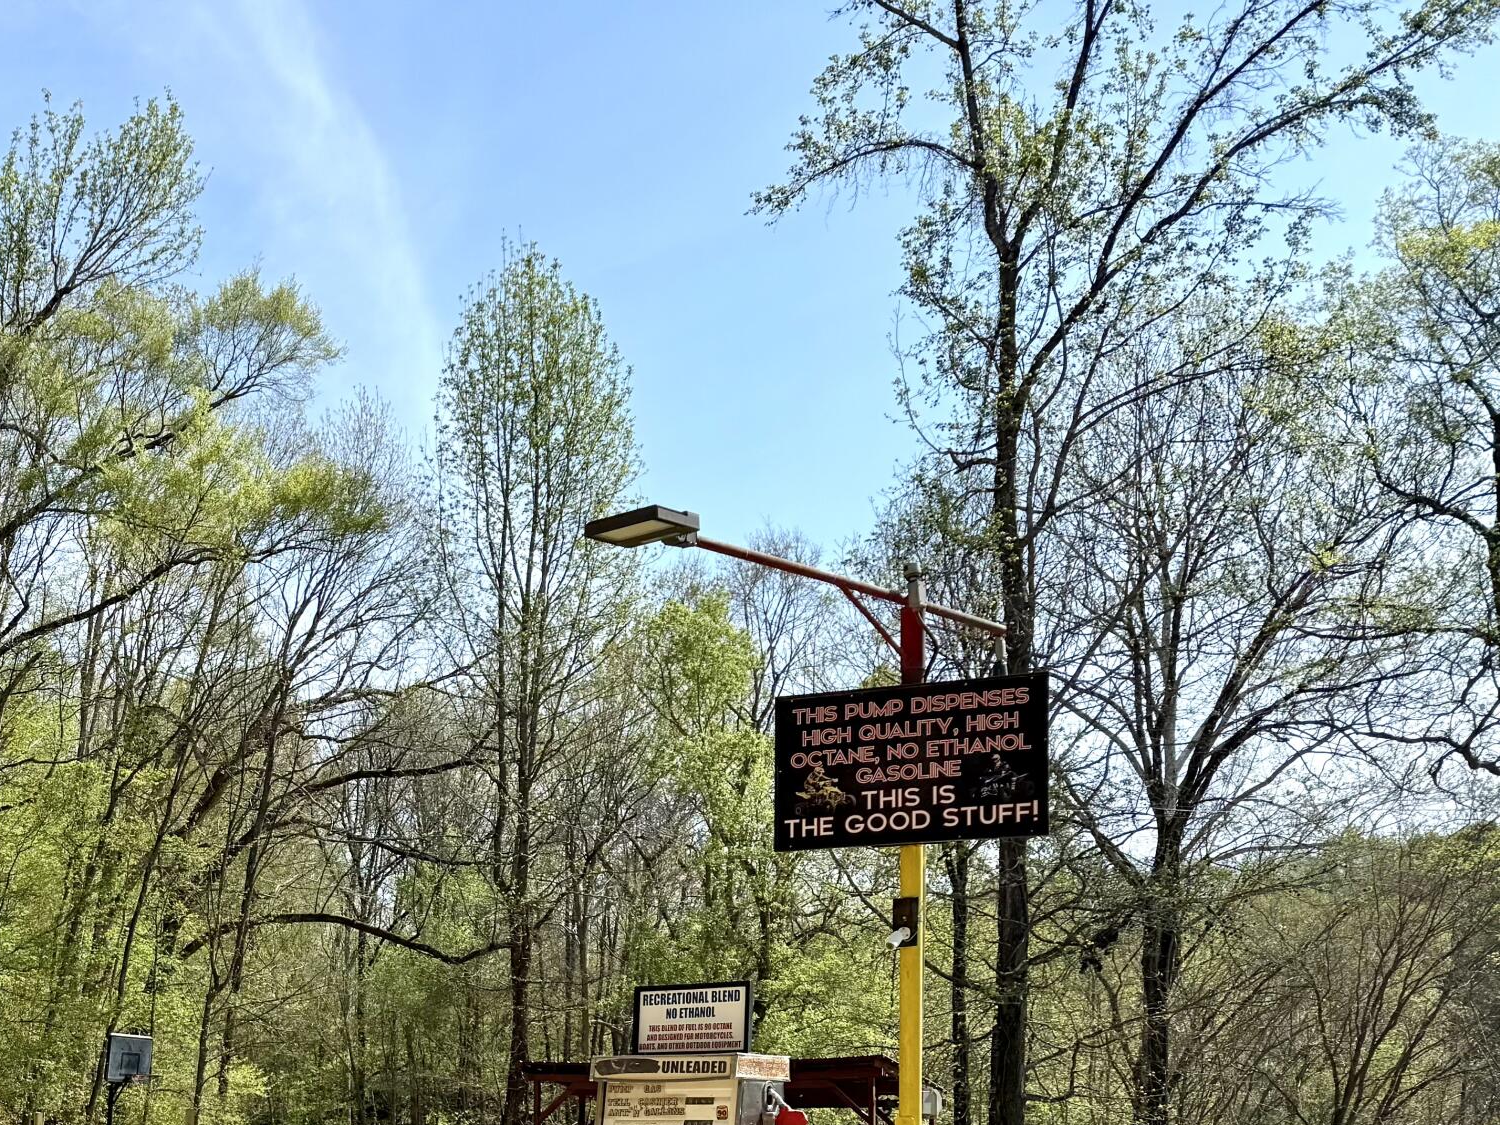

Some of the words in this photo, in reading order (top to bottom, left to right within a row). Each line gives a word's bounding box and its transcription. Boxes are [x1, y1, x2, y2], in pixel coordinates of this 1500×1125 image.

[792, 706, 837, 725] THIS
[844, 699, 903, 720] PUMP
[910, 687, 1030, 714] DISPENSES
[802, 727, 851, 747] HIGH
[858, 717, 958, 740] QUALITY,
[966, 711, 1019, 732] HIGH
[790, 746, 880, 769] OCTANE,
[887, 741, 918, 761] NO
[926, 733, 1031, 758] ETHANOL
[855, 760, 962, 784] GASOLINE
[861, 787, 920, 810] THIS
[933, 785, 956, 805] IS
[784, 816, 834, 838] THE
[845, 810, 930, 834] GOOD
[943, 800, 1039, 827] STUFF!
[643, 991, 709, 1006] RECREATIONAL
[712, 990, 740, 1002] BLEND
[666, 1008, 677, 1019] NO
[680, 1007, 715, 1018] ETHANOL
[658, 1033, 683, 1041] DESIGNED
[662, 1061, 727, 1073] UNLEADED
